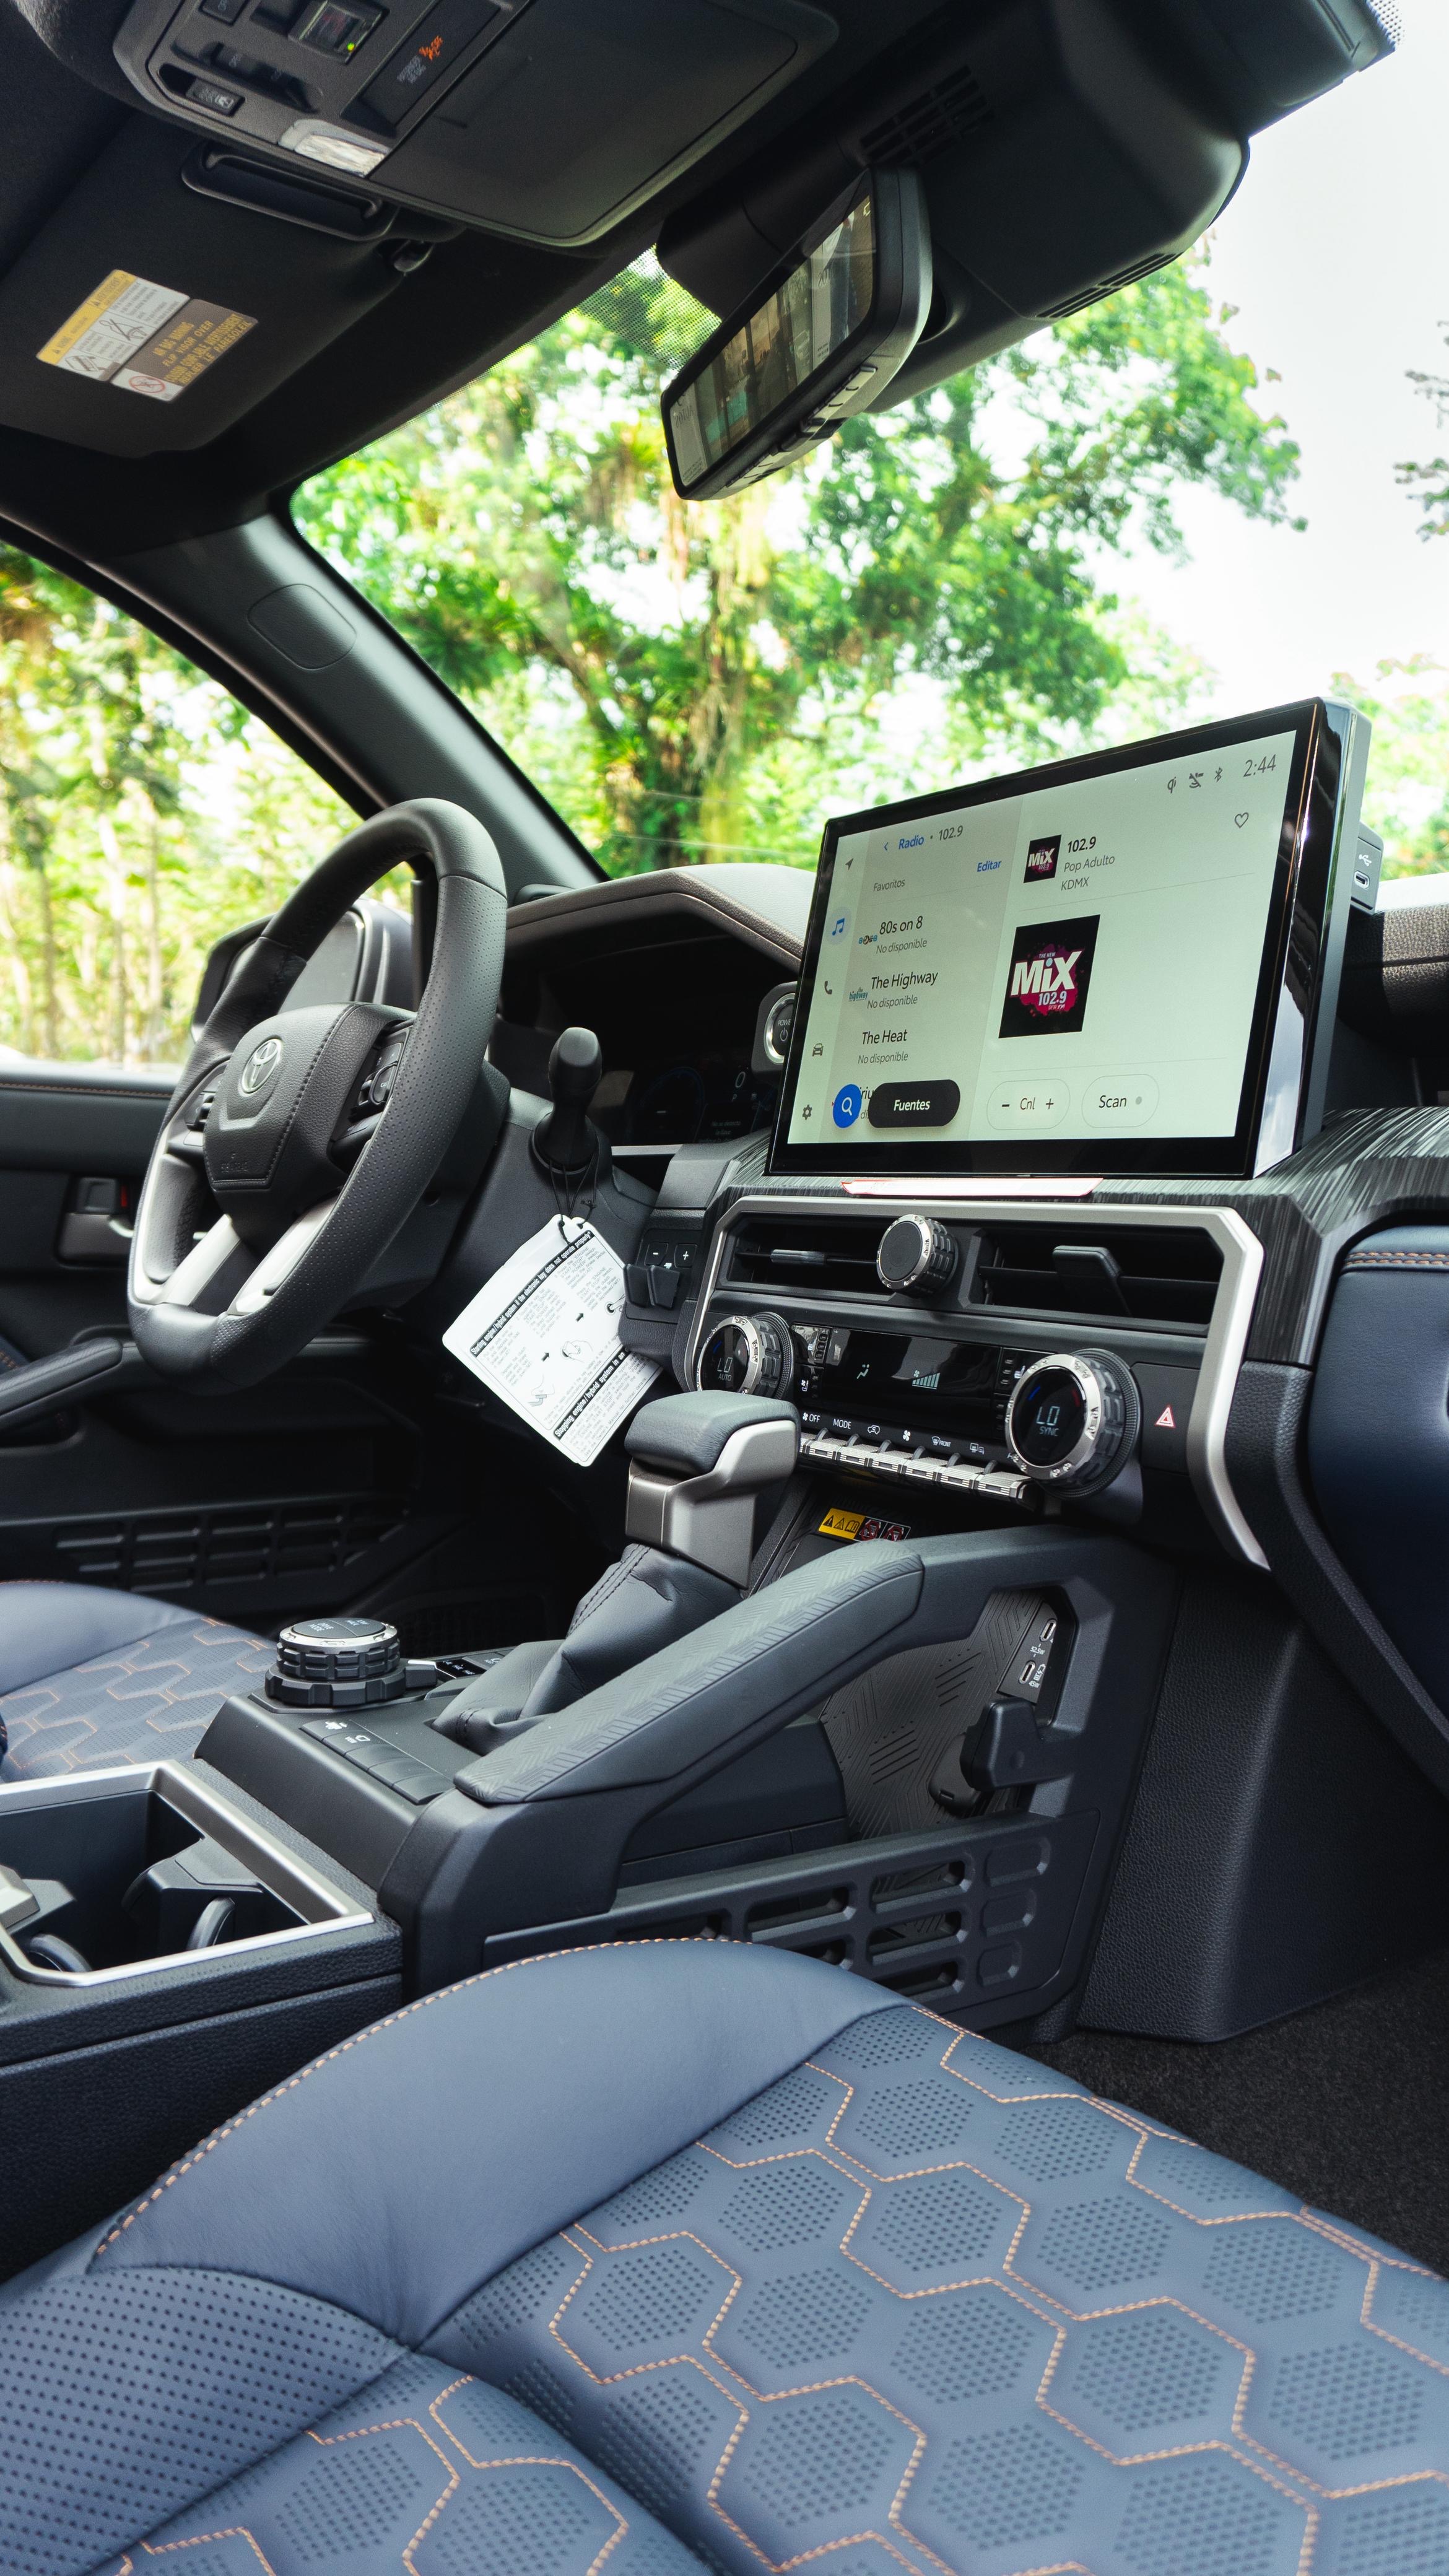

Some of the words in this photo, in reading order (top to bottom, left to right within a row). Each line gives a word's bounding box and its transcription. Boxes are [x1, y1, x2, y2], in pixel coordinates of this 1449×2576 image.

[175, 337, 197, 354] VISOR
[194, 320, 214, 337] OVER
[203, 352, 215, 362] LE
[1243, 754, 1276, 777] 2:44
[899, 835, 925, 850] Radio
[939, 825, 963, 841] 102.9
[1068, 837, 1097, 853] 102.9
[977, 860, 1002, 872] Editar
[1064, 861, 1081, 873] Pop
[1084, 855, 1115, 868] Adulto
[873, 879, 905, 892] Favoritos
[1061, 877, 1090, 891] KDMX
[879, 921, 897, 935] 80s
[900, 923, 913, 932] on
[916, 915, 923, 929] 8
[876, 944, 887, 954] No
[889, 938, 928, 952] disponible
[871, 977, 889, 990] The
[891, 972, 939, 990] Highway
[867, 1000, 877, 1009] No
[879, 994, 918, 1009] disponible
[1038, 991, 1068, 1006] 102.9
[862, 1031, 879, 1045] The
[882, 1029, 908, 1043] Heat
[858, 1055, 869, 1064] No
[869, 1051, 909, 1065] disponible
[734, 1071, 746, 1089] 0
[731, 1093, 738, 1103] P
[894, 1099, 931, 1111] Fuentes
[1020, 1097, 1035, 1110] Cnl
[1099, 1095, 1127, 1108] Scan
[470, 1338, 486, 1355] Starting
[503, 1303, 518, 1318] system
[516, 1292, 526, 1302] the
[522, 1277, 541, 1296] electronic
[536, 1271, 547, 1281] key
[543, 1262, 555, 1273] does
[552, 1256, 563, 1265] not
[560, 1245, 577, 1260] operate
[554, 1414, 575, 1437] Stopping
[598, 1364, 614, 1383] system
[611, 1358, 619, 1366] in
[617, 1351, 625, 1360] an
[809, 1414, 820, 1422] OFF
[833, 1418, 851, 1429] MODE
[1040, 1426, 1060, 1436] SYNC
[1029, 1680, 1040, 1688] 45W
